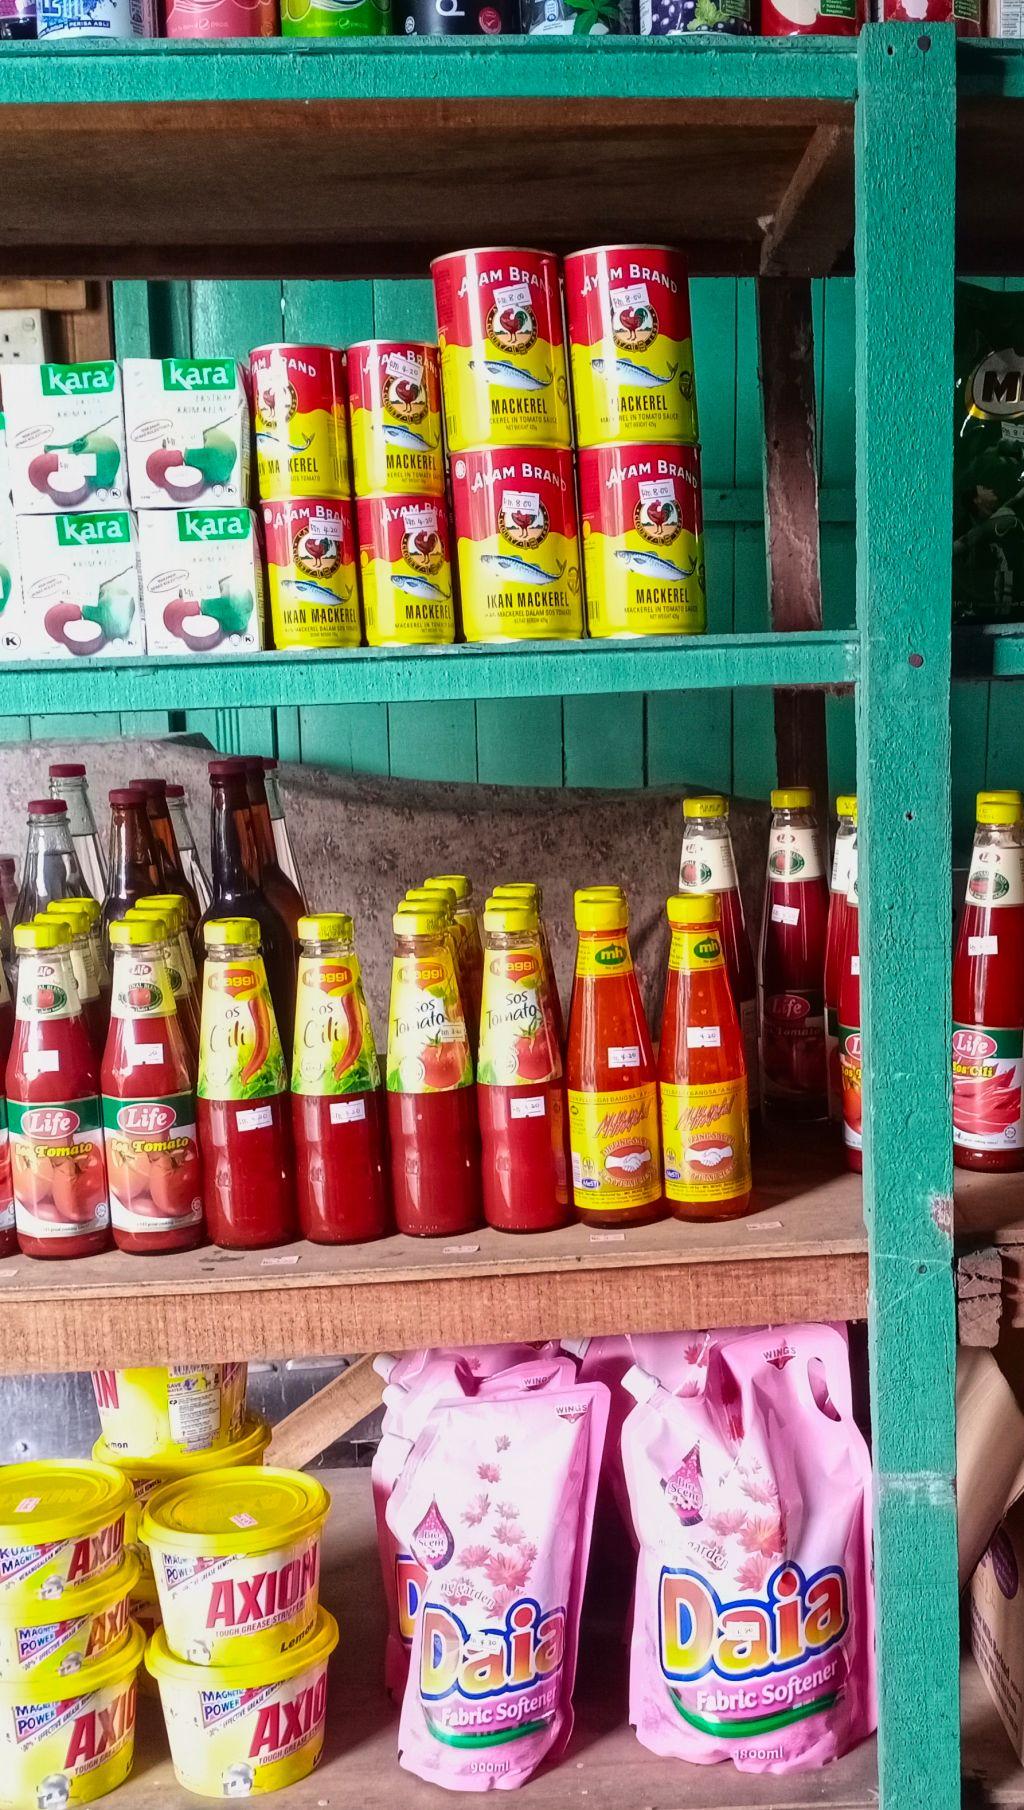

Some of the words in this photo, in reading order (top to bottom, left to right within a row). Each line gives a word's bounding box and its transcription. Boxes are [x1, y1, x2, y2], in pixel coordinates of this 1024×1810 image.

[629, 264, 677, 293] BRAND
[49, 367, 111, 395] kara
[170, 360, 230, 391] kara
[491, 398, 548, 415] MACKEREL
[617, 396, 668, 412] ACKEREL
[386, 453, 437, 471] MACKEREL
[522, 463, 567, 492] BRAND
[606, 461, 651, 488] AYAM
[657, 459, 698, 488] BRAND
[65, 518, 124, 546] kara
[185, 513, 244, 541] kara
[487, 594, 513, 609] IKAN
[517, 592, 570, 608] MACKEREL
[637, 588, 690, 604] MACKEREL
[284, 609, 307, 625] IKAN
[311, 607, 356, 625] MACKEREL
[405, 603, 452, 620] MACKEREL
[601, 947, 623, 960] mh
[699, 940, 719, 953] mh
[957, 1032, 989, 1056] Life
[29, 1112, 71, 1133] Life
[125, 1107, 168, 1129] Life
[34, 1141, 93, 1158] Tomato
[132, 1136, 188, 1152] Tomato
[762, 1346, 797, 1361] WINGS
[418, 1538, 445, 1548] Scent
[206, 1541, 320, 1629] AXION
[242, 1618, 270, 1632] GREASE
[664, 1569, 844, 1676] Daia
[280, 1620, 314, 1653] Lemon
[424, 1601, 566, 1697] Daia
[696, 1689, 757, 1713] Fabric
[761, 1658, 838, 1705] Softener
[204, 1699, 239, 1720] POWER
[441, 1703, 492, 1728] Fabric
[495, 1687, 557, 1721] Softener
[18, 1710, 55, 1735] POWER
[470, 1759, 510, 1774] 900ml
